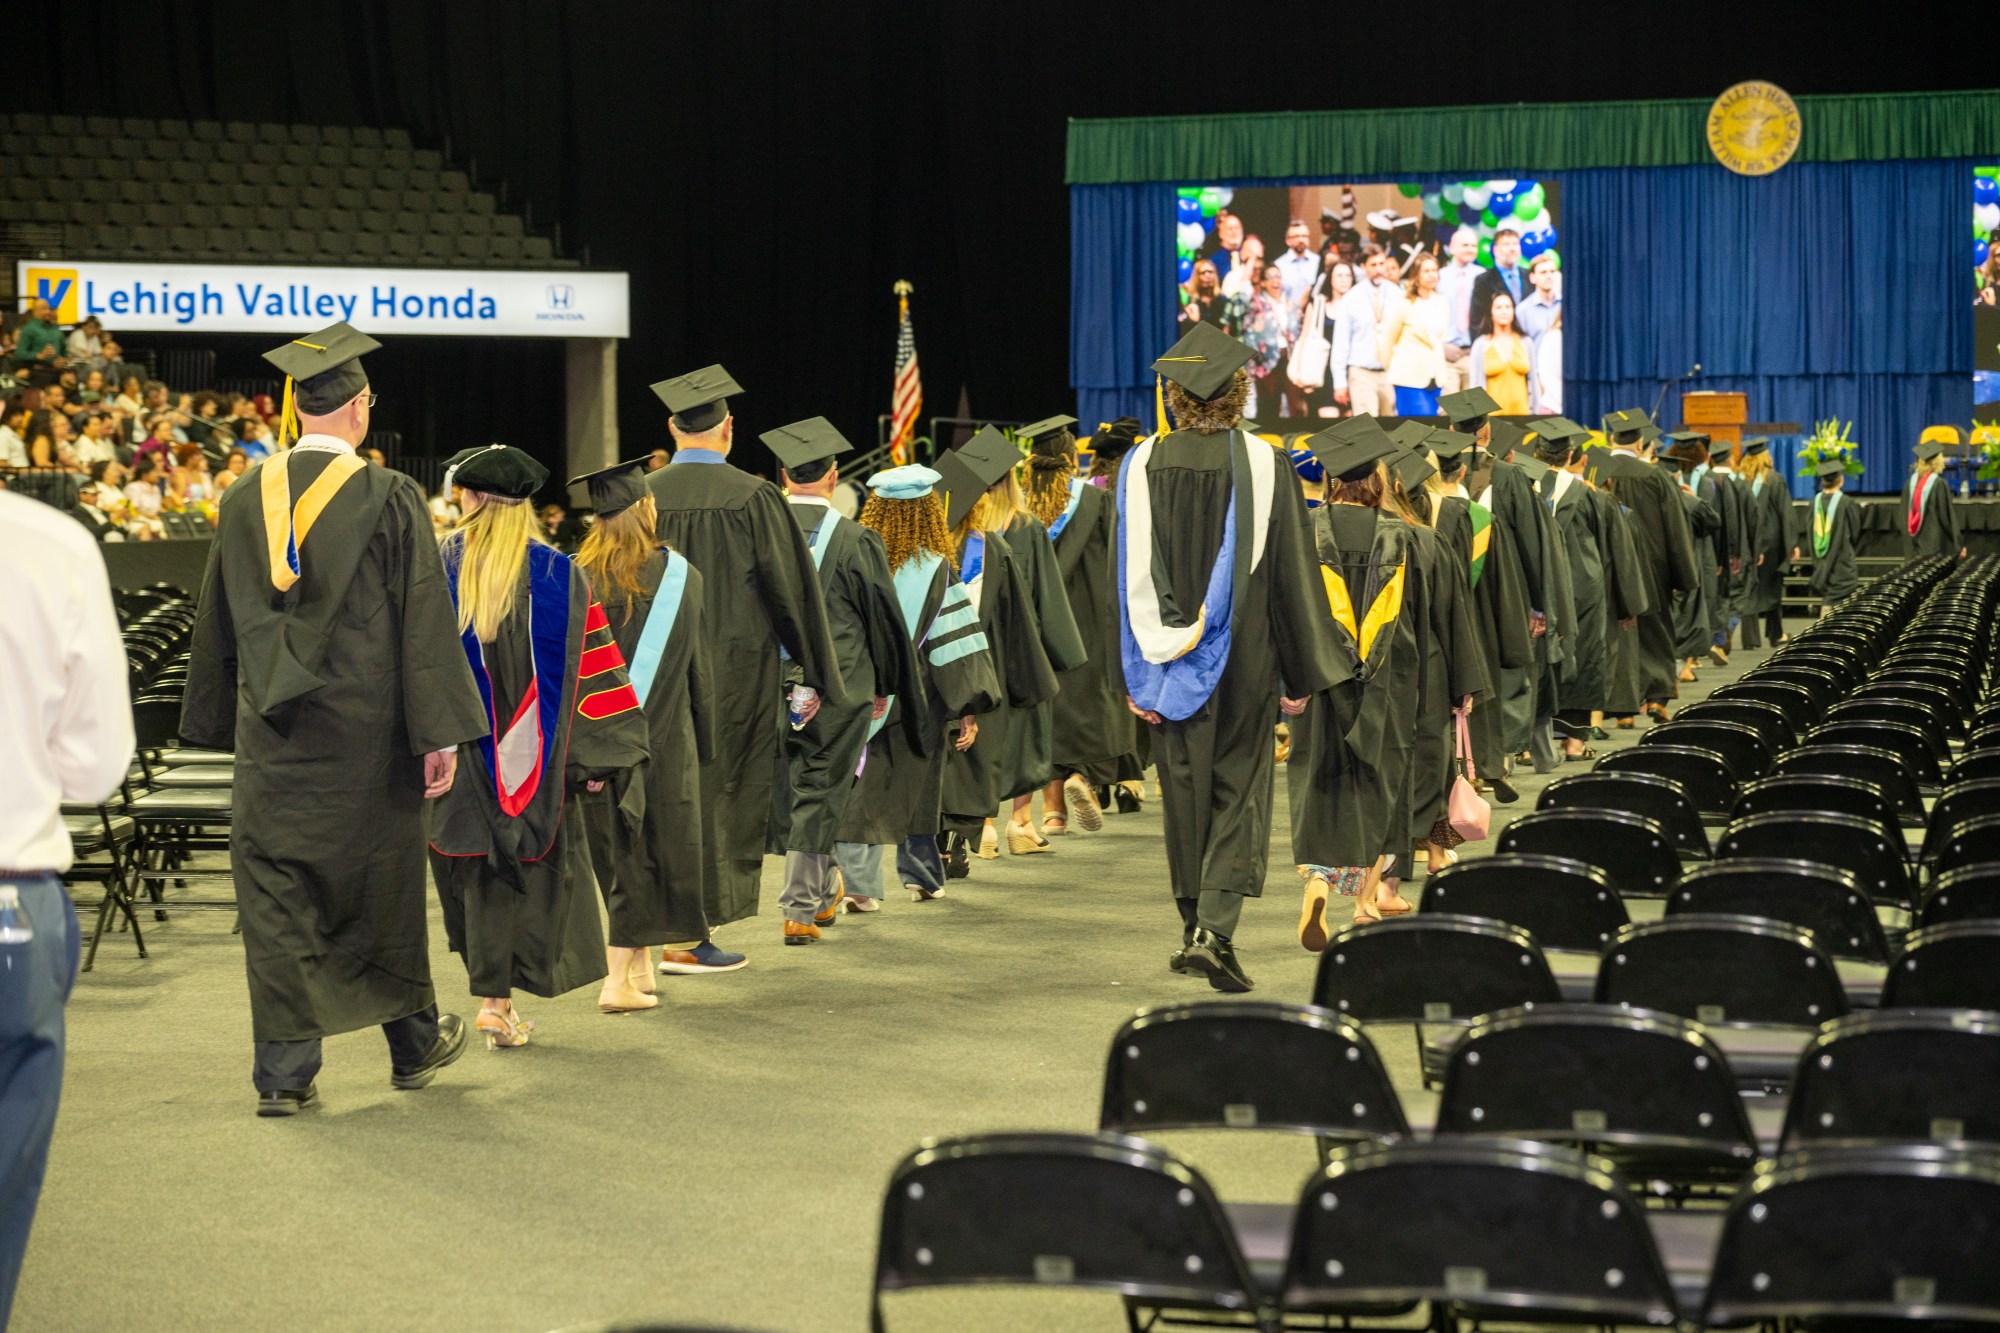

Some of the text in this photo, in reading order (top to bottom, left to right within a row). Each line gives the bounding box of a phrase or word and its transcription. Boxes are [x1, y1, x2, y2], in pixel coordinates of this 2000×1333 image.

[86, 281, 497, 324] Lehigh Valley Honda
[536, 313, 585, 321] HONDA
